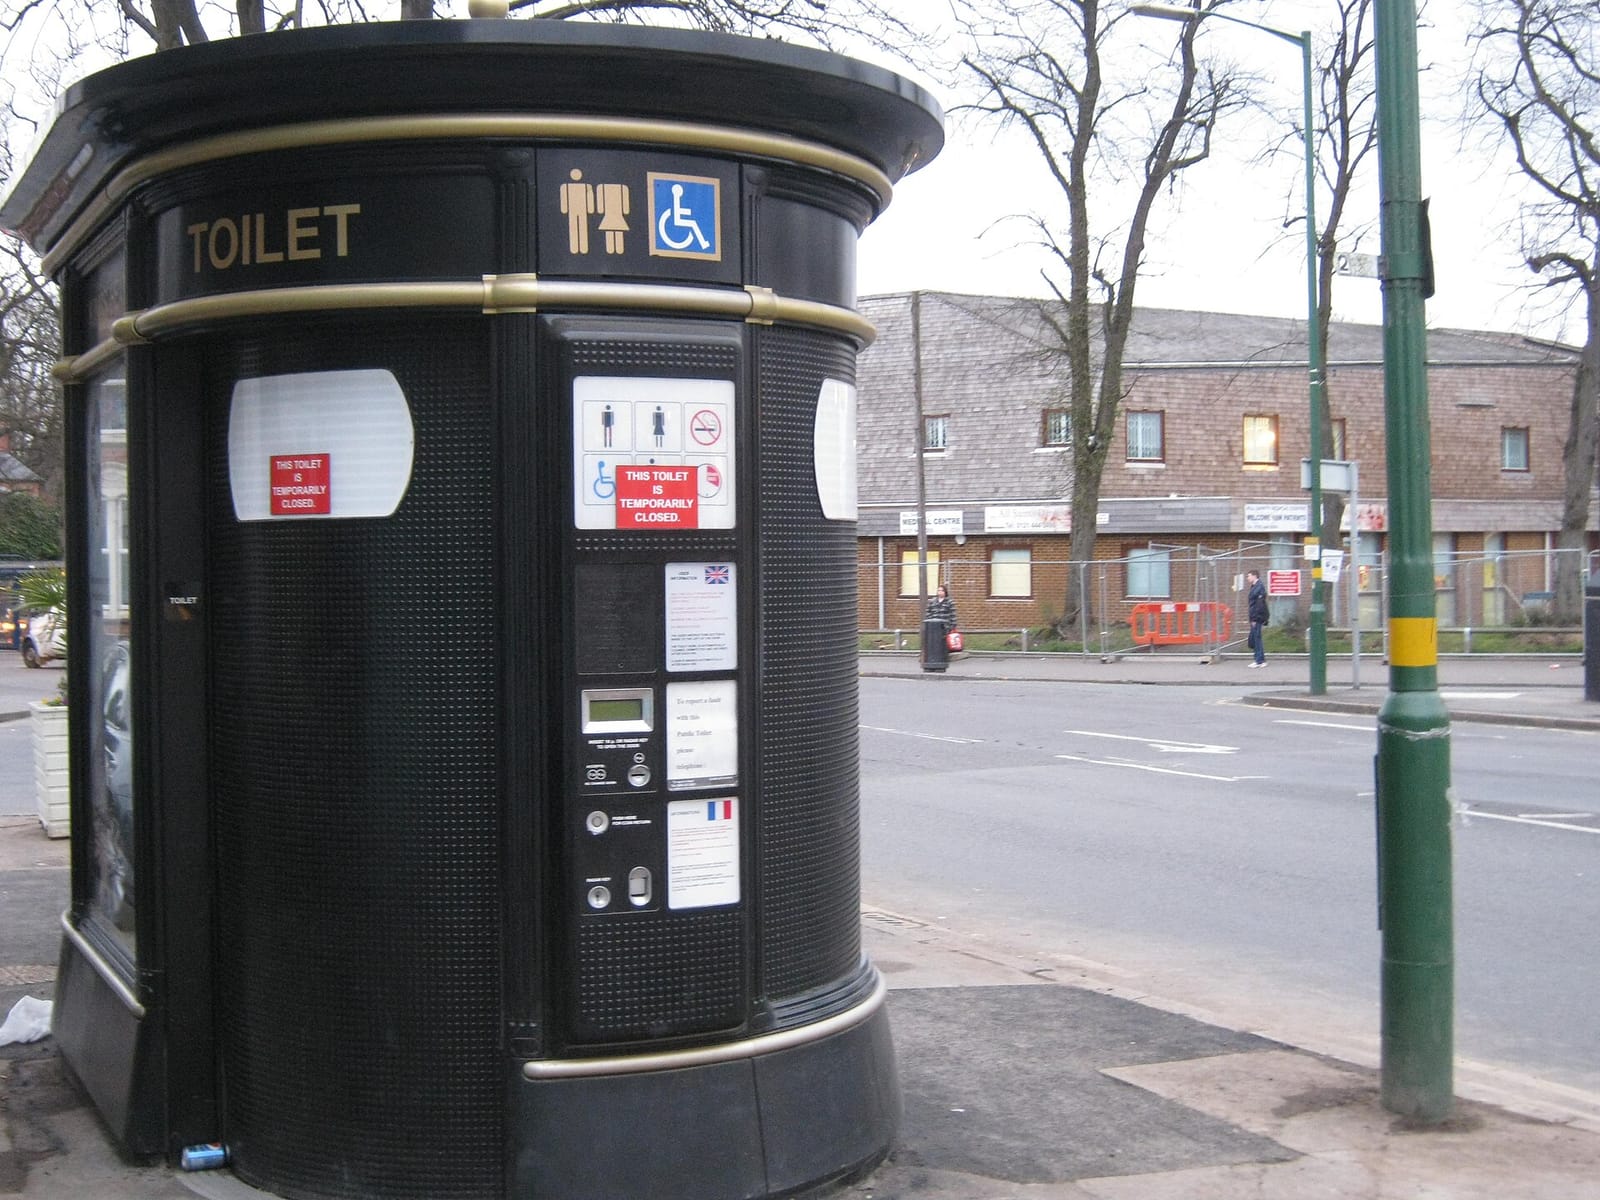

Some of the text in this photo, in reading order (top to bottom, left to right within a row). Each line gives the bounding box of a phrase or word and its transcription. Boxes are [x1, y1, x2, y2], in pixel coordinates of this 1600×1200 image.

[187, 203, 361, 273] TOILET
[1337, 254, 1349, 271] 2
[276, 459, 322, 470] THIS TOILET
[294, 472, 303, 482] IS
[625, 471, 689, 481] THIS TOILET
[272, 485, 327, 496] TEMPORARILY
[652, 485, 664, 495] IS
[282, 498, 316, 508] CLOSED.
[620, 498, 694, 509] TEMPORARILY
[634, 512, 681, 522] CLOSED.
[933, 517, 961, 525] CENTRE
